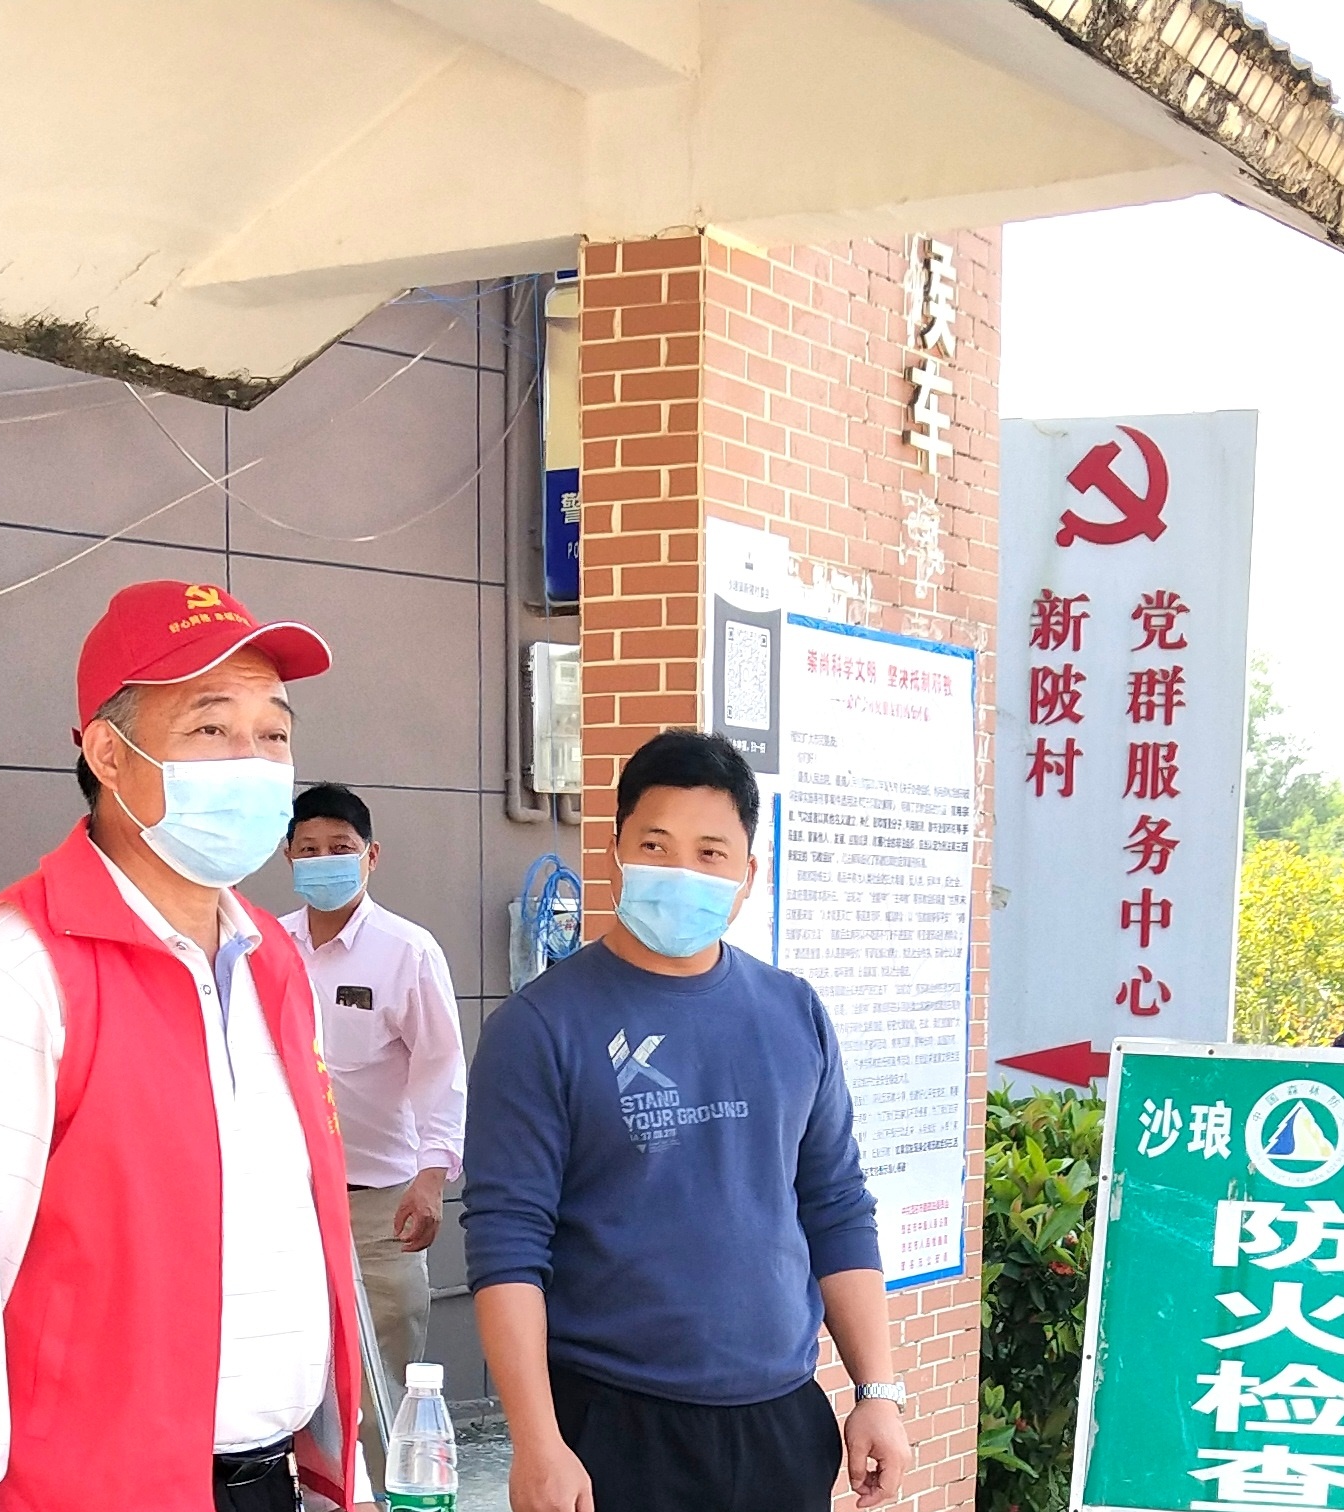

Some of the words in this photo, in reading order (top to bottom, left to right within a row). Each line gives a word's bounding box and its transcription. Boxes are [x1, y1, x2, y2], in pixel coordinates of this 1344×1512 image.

[1025, 588, 1090, 798] 新陂村
[1115, 589, 1190, 1018] 党群服务中心
[619, 1089, 680, 1114] STAND
[622, 1108, 674, 1132] YOUR
[677, 1100, 749, 1125] GROUND
[1137, 1098, 1232, 1160] 沙琅
